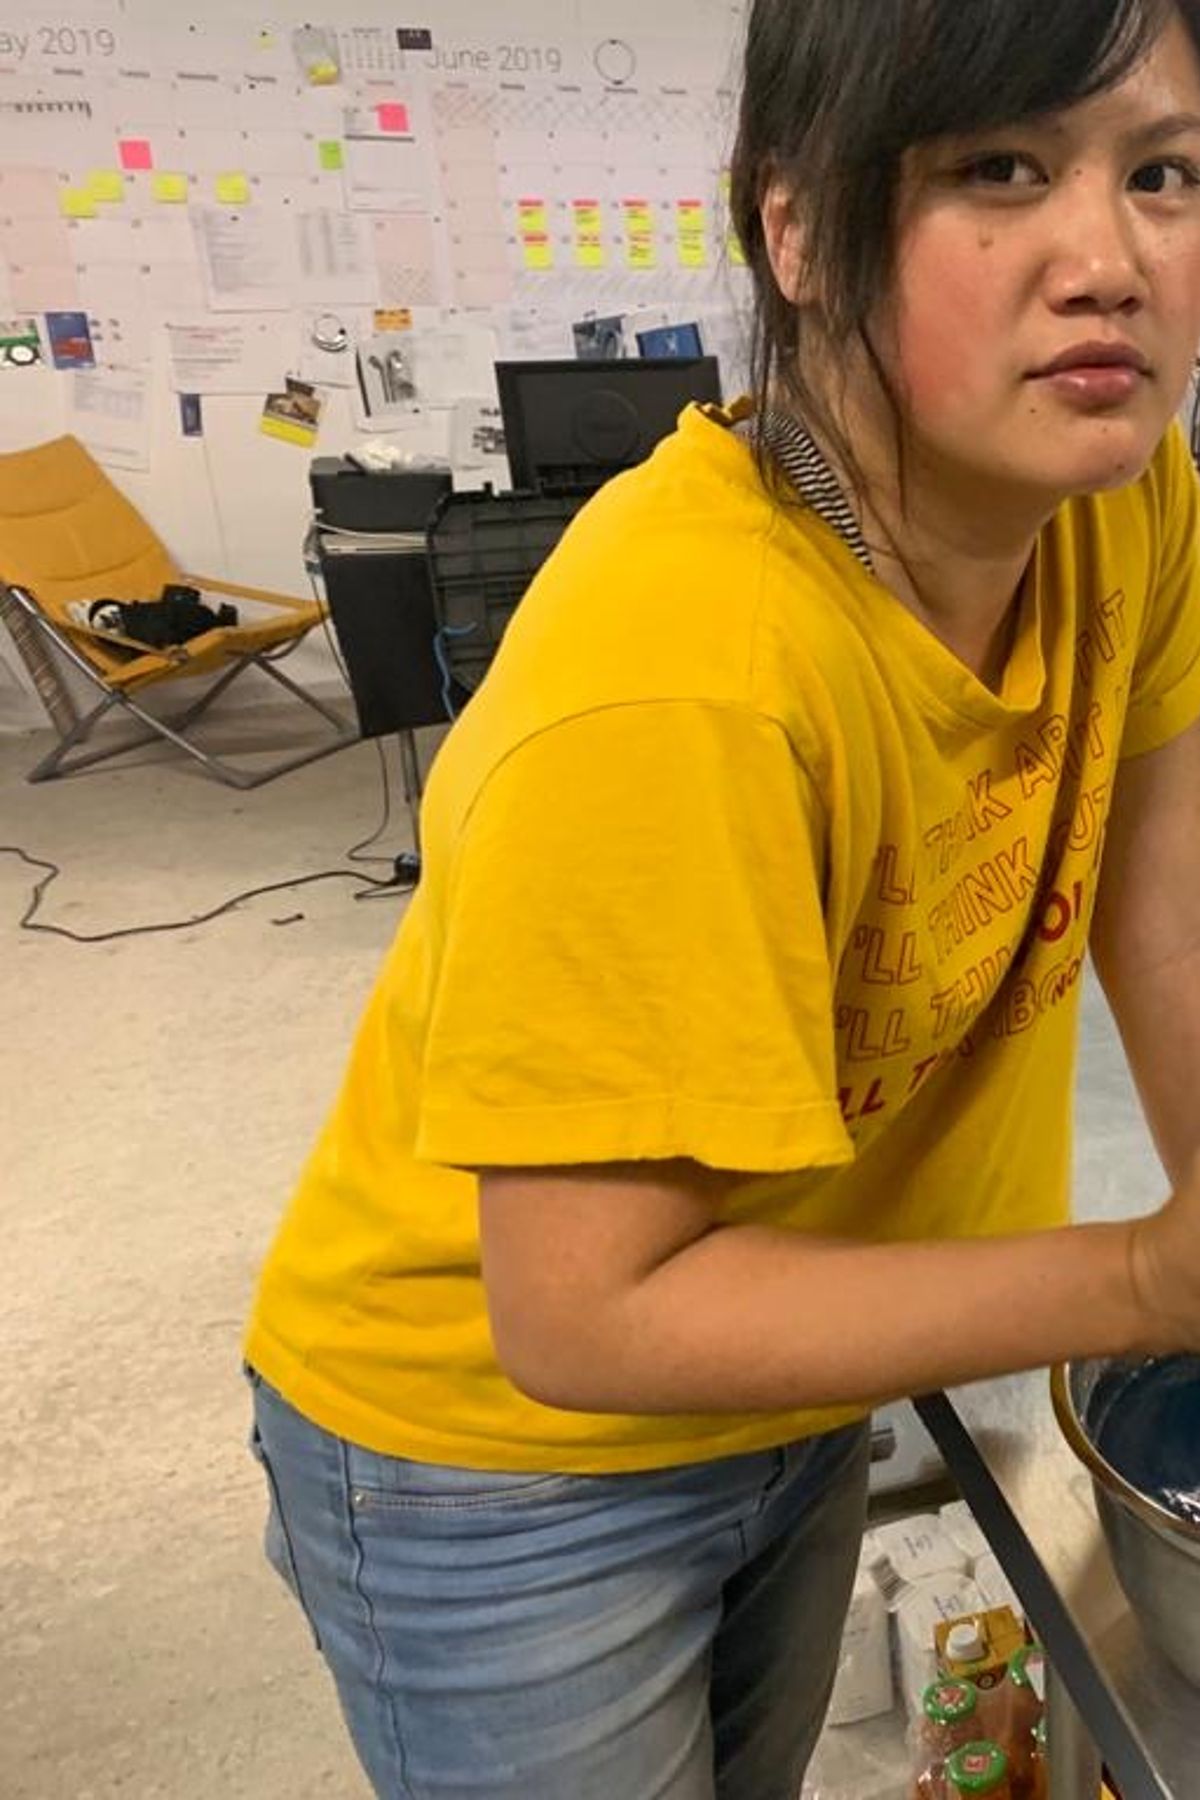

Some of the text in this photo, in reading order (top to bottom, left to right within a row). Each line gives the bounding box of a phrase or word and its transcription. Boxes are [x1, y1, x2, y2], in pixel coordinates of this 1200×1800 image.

[35, 27, 115, 57] 2019
[424, 47, 491, 71] June
[498, 46, 562, 73] 2019
